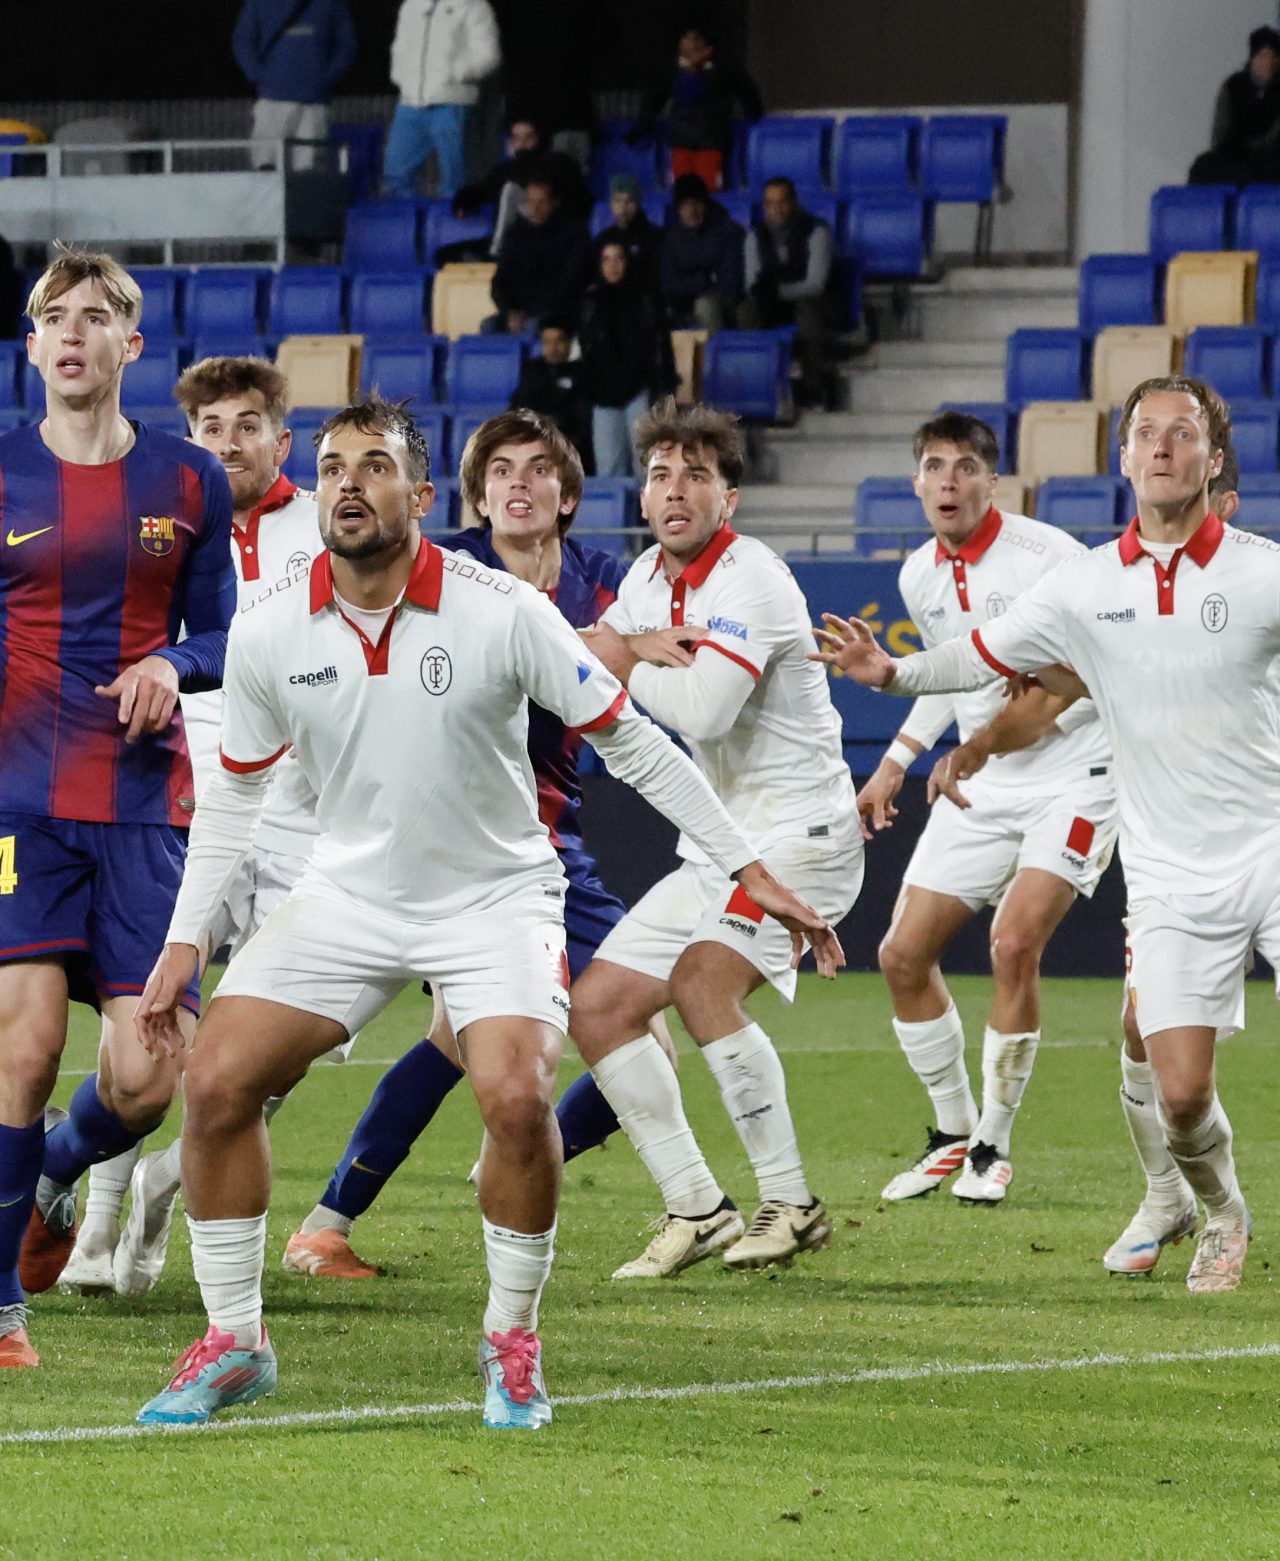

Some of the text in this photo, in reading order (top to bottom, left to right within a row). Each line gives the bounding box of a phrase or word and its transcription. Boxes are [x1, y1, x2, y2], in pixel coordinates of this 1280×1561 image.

[1096, 608, 1136, 622] capelli
[289, 665, 338, 686] capelli
[718, 917, 758, 938] capelli
